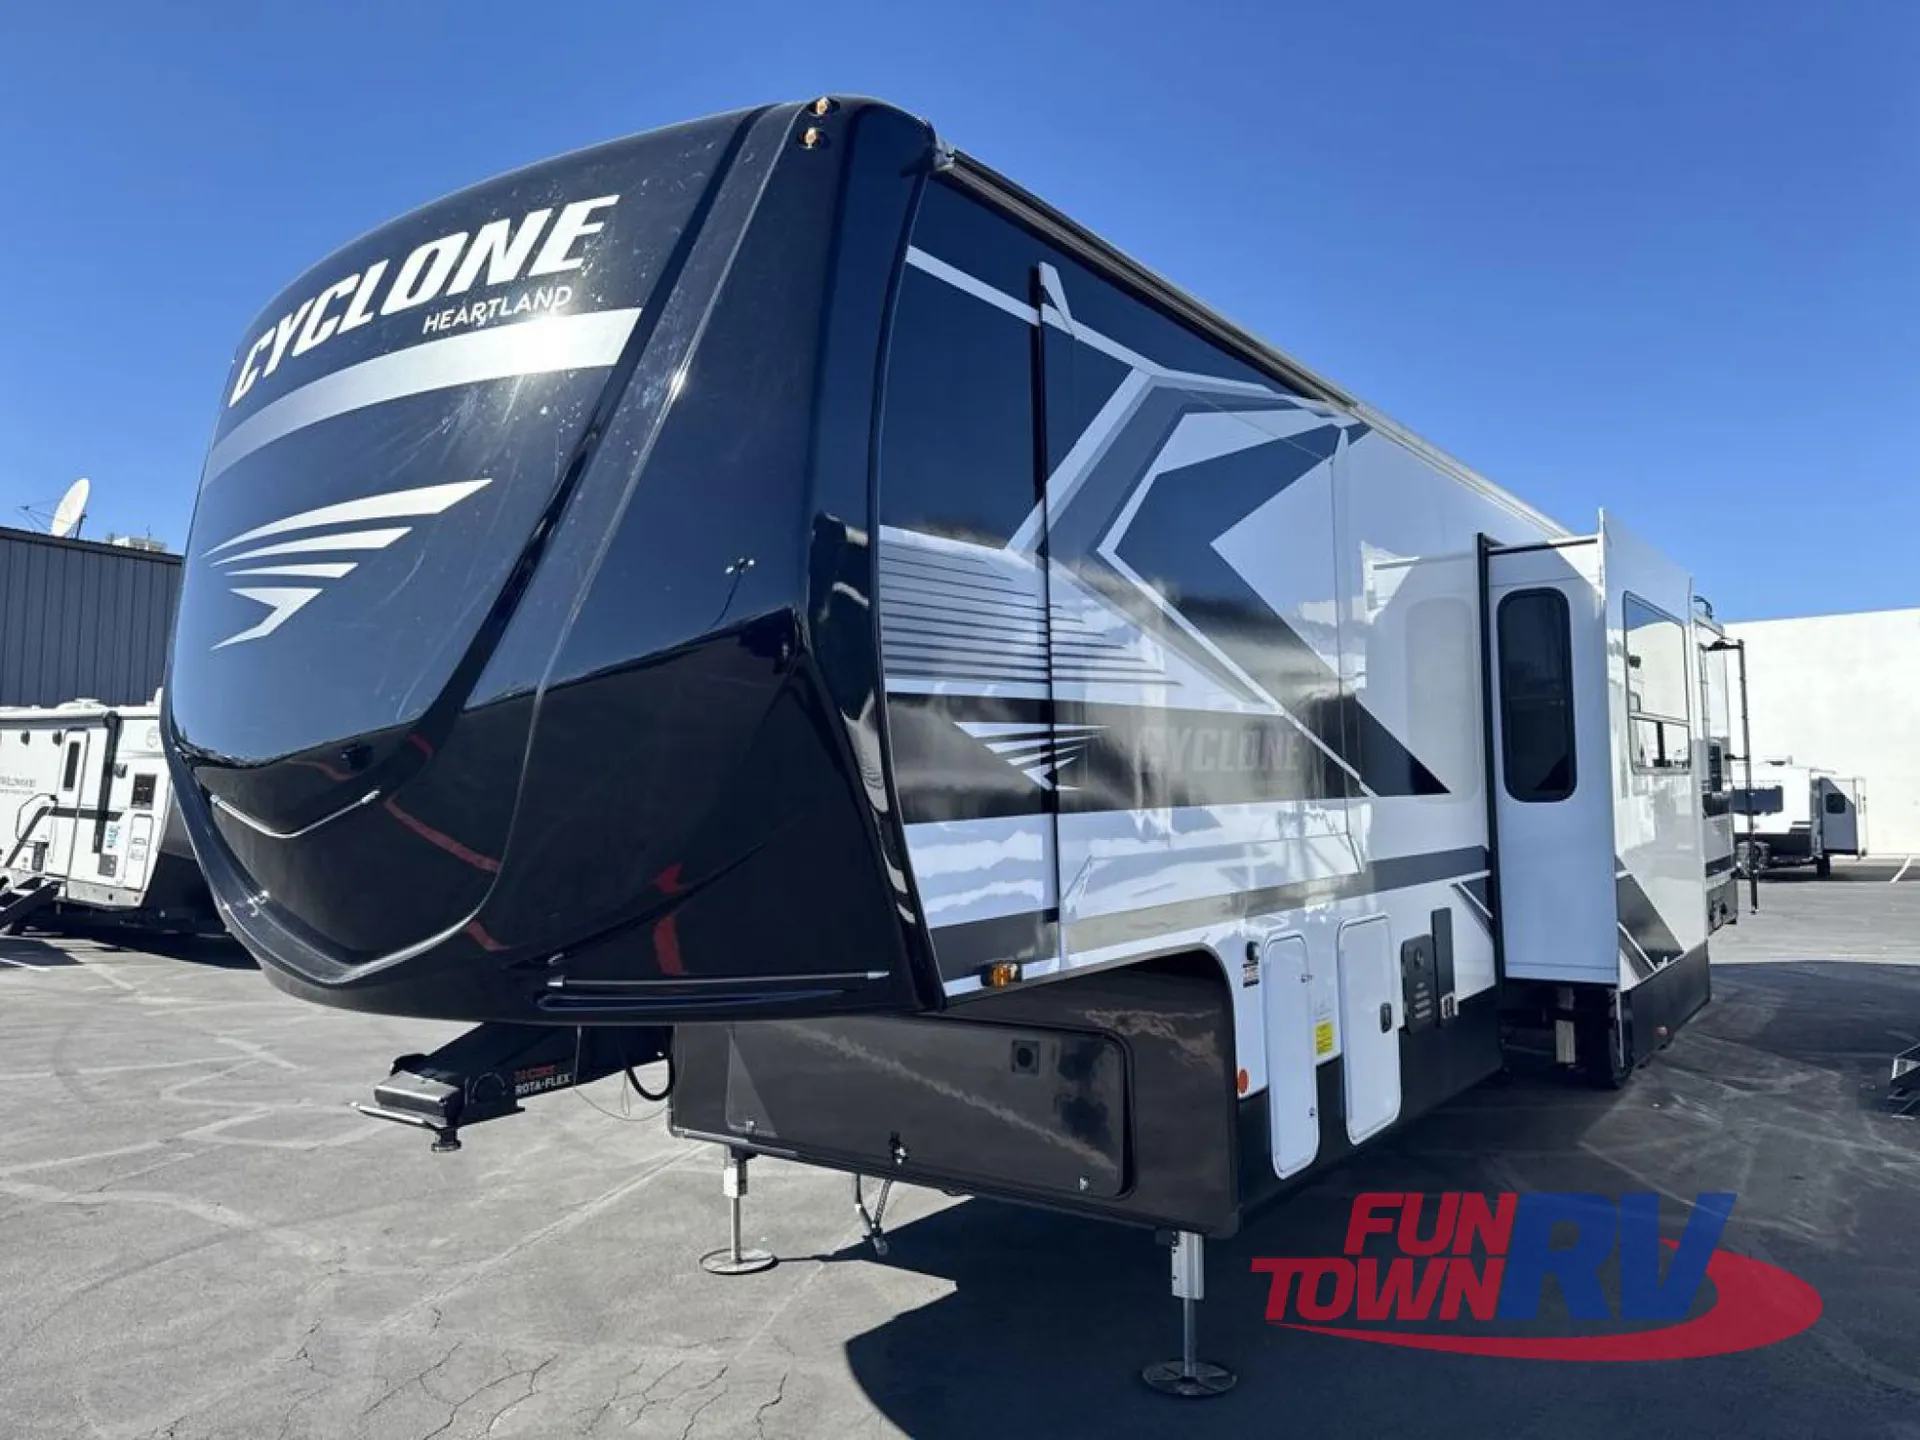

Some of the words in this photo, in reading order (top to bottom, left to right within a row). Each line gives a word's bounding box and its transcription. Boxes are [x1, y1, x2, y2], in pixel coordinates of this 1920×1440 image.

[229, 194, 620, 408] CYCLONE
[422, 286, 573, 335] HEARTLAND
[1140, 726, 1299, 774] CYCLONE
